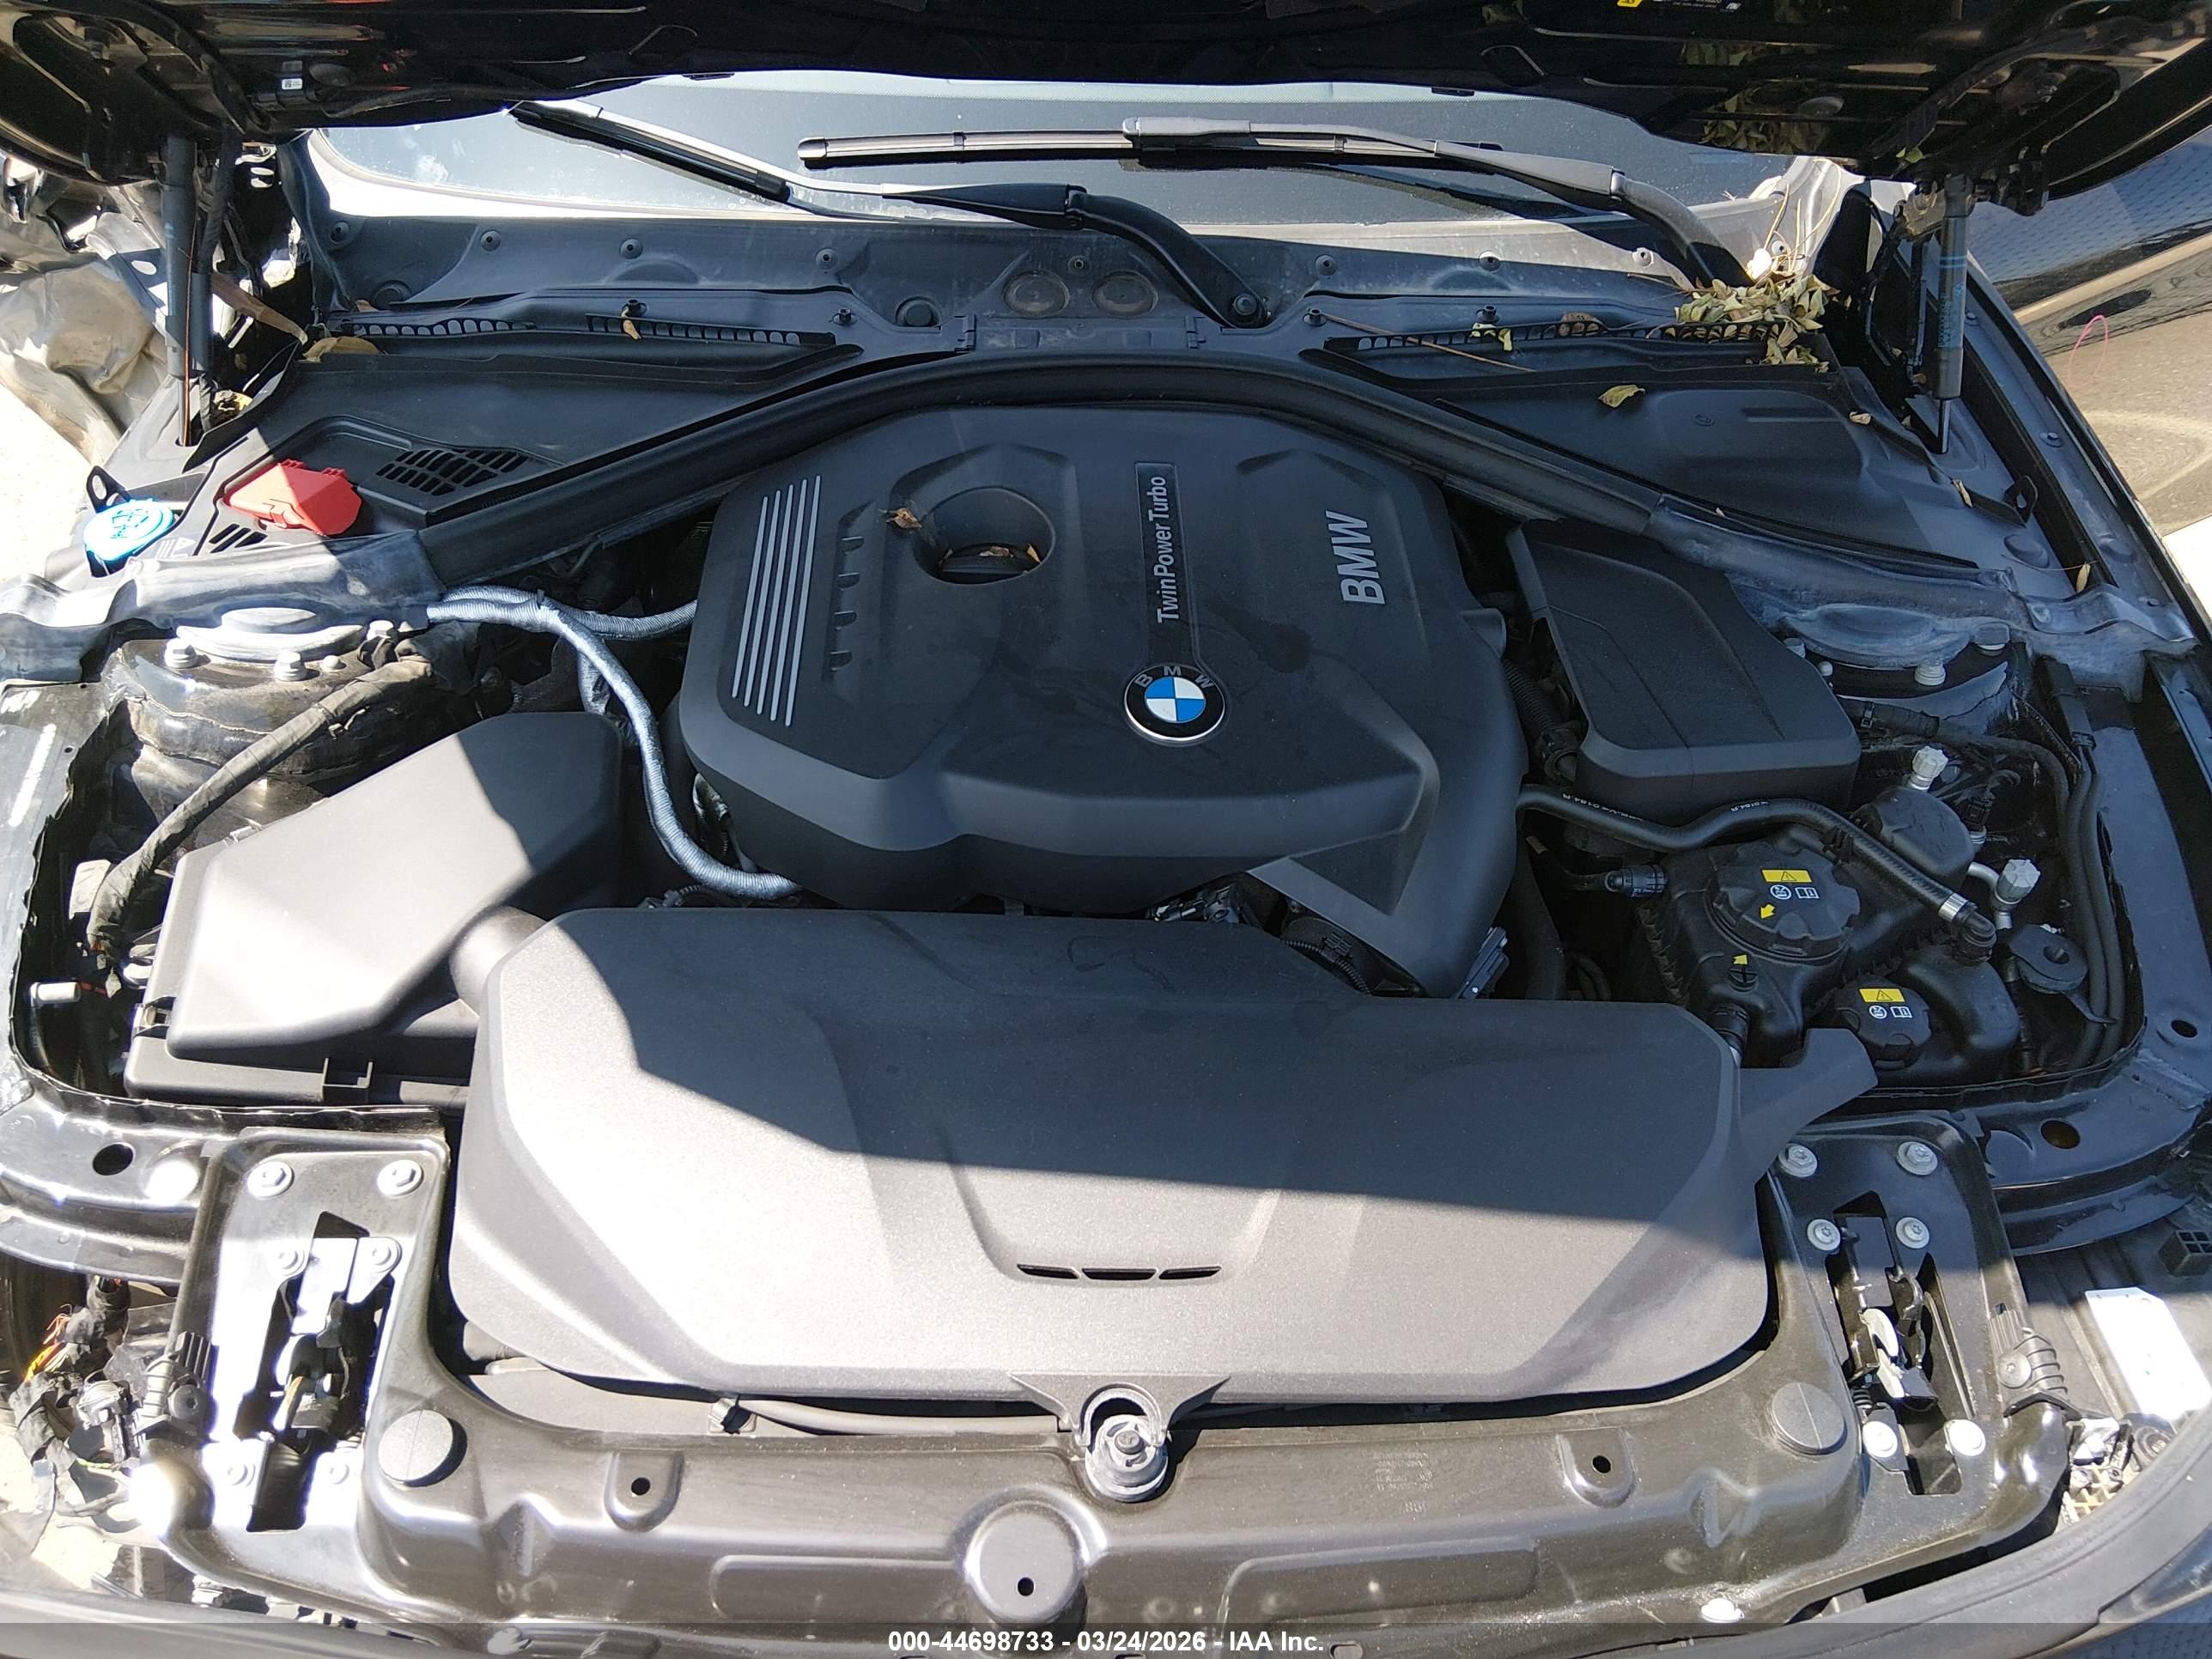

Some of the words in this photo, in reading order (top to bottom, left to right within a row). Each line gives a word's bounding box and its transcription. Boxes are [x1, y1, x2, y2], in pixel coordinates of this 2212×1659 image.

[1146, 477, 1170, 521] Turbo
[1154, 523, 1180, 623] TwinPower
[1325, 510, 1386, 605] BMW
[1133, 665, 1214, 689] BMW
